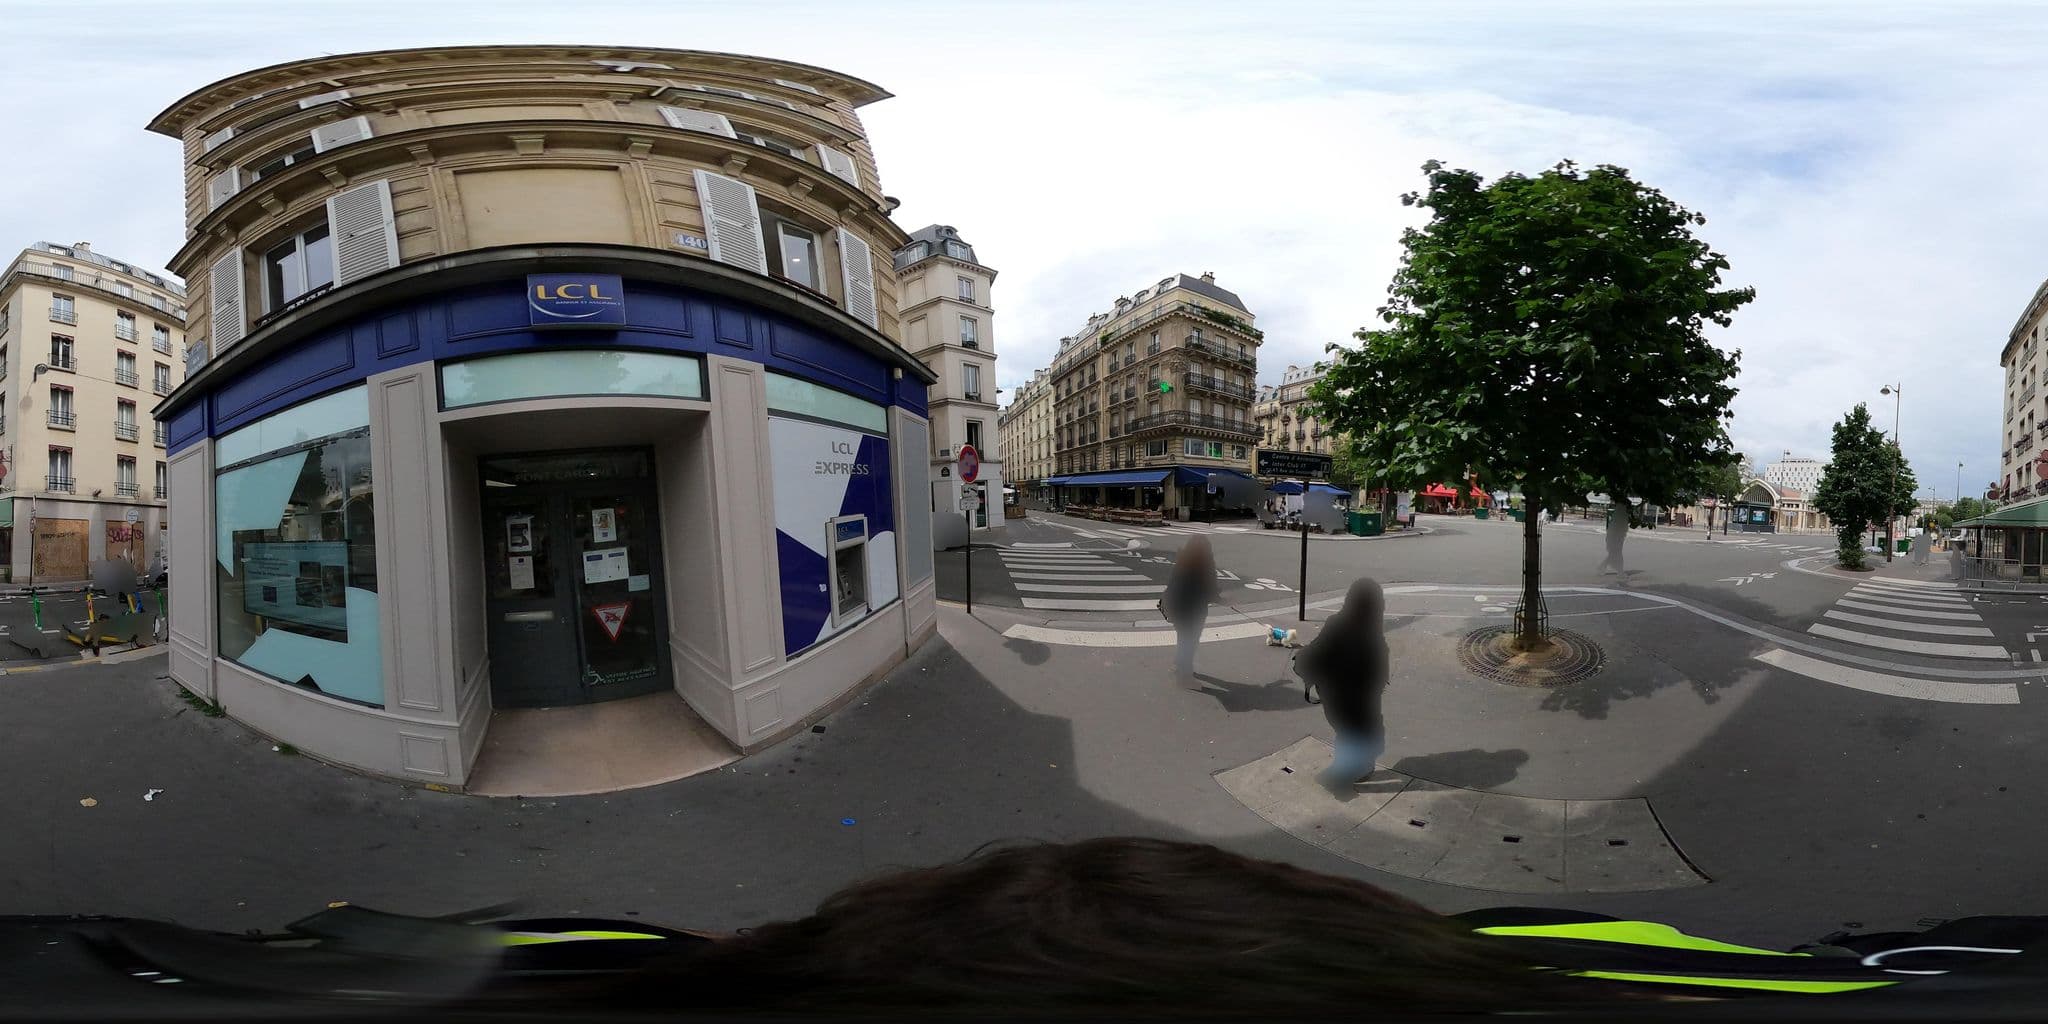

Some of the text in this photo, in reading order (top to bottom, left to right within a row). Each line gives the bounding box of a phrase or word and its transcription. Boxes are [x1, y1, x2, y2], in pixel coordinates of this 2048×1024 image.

[678, 234, 707, 249] 140
[536, 283, 613, 300] LCL
[832, 442, 853, 454] LCL
[815, 462, 869, 475] EXPRESS
